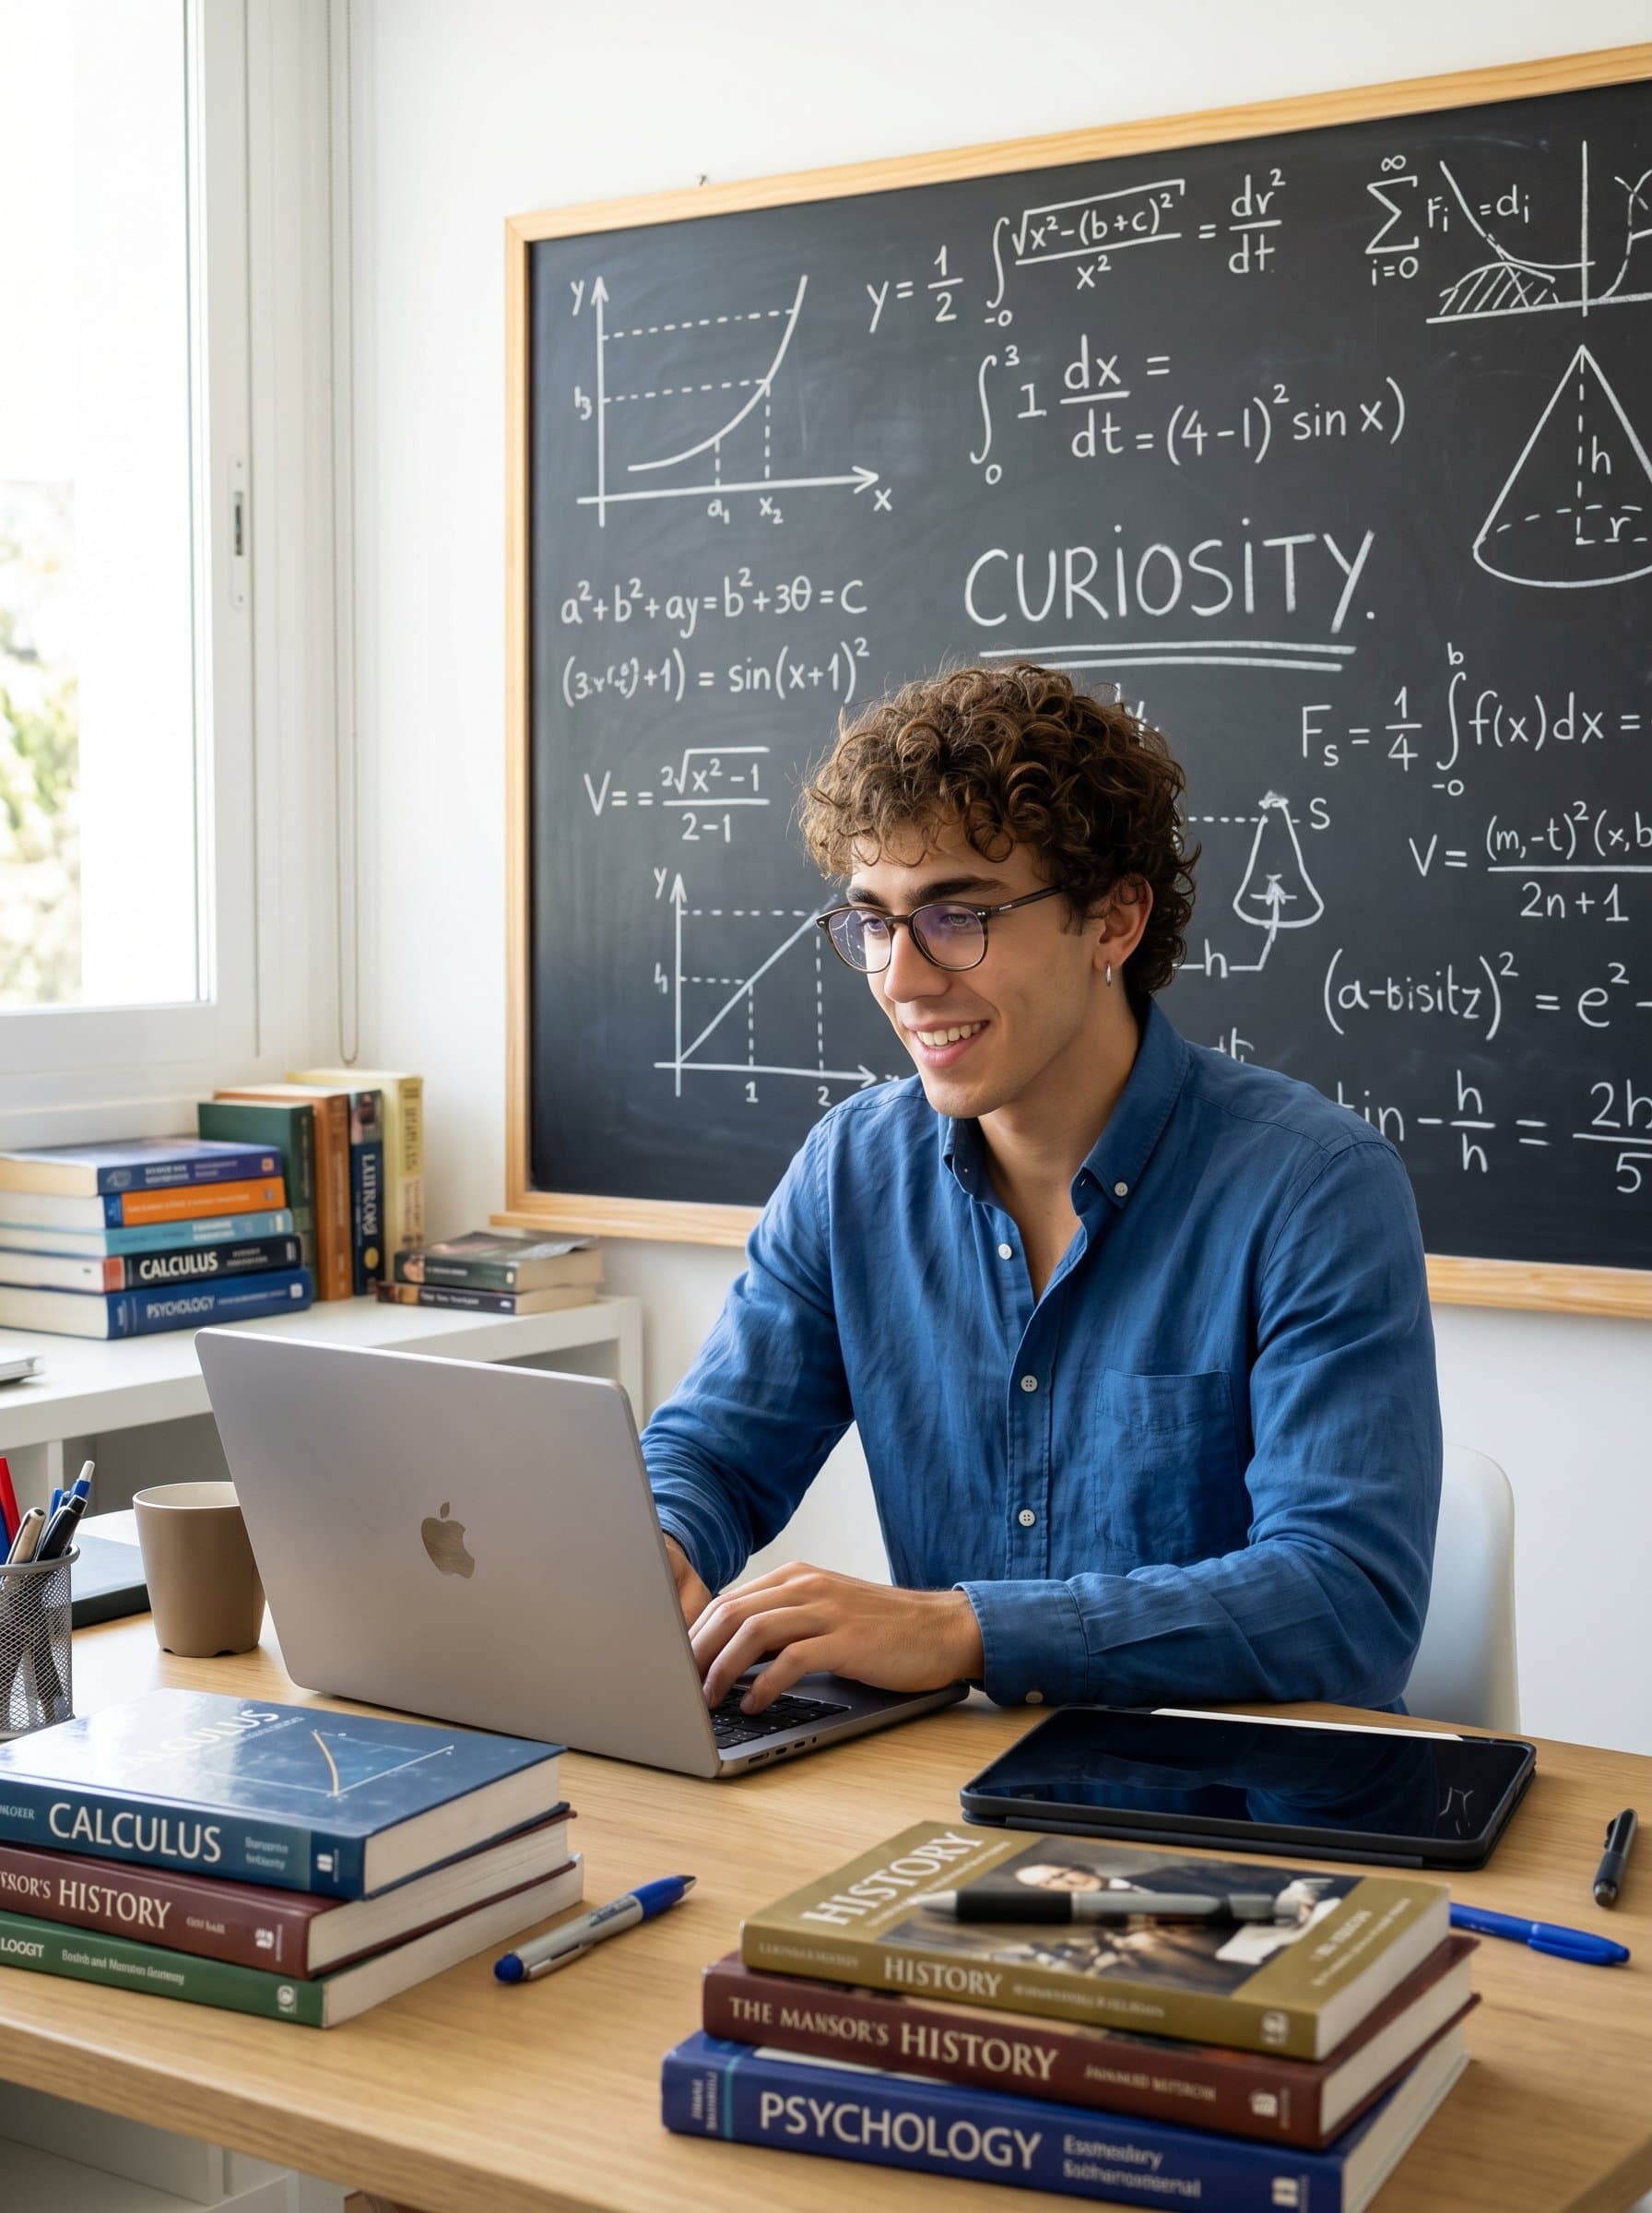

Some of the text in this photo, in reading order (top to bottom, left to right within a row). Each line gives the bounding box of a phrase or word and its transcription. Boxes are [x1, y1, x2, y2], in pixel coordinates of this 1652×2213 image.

[140, 1251, 218, 1280] CALCULUS
[147, 1296, 215, 1319] PSYCHOLOGY
[48, 1802, 222, 1864] CALCULUS
[58, 1878, 171, 1930] HISTORY
[800, 1830, 985, 1925] HISTORY
[884, 1956, 1003, 1998] HISTORY
[729, 1996, 773, 2024] THE
[900, 2023, 1058, 2081] HISTORY
[760, 2091, 1042, 2170] PSYCHOLOGY
